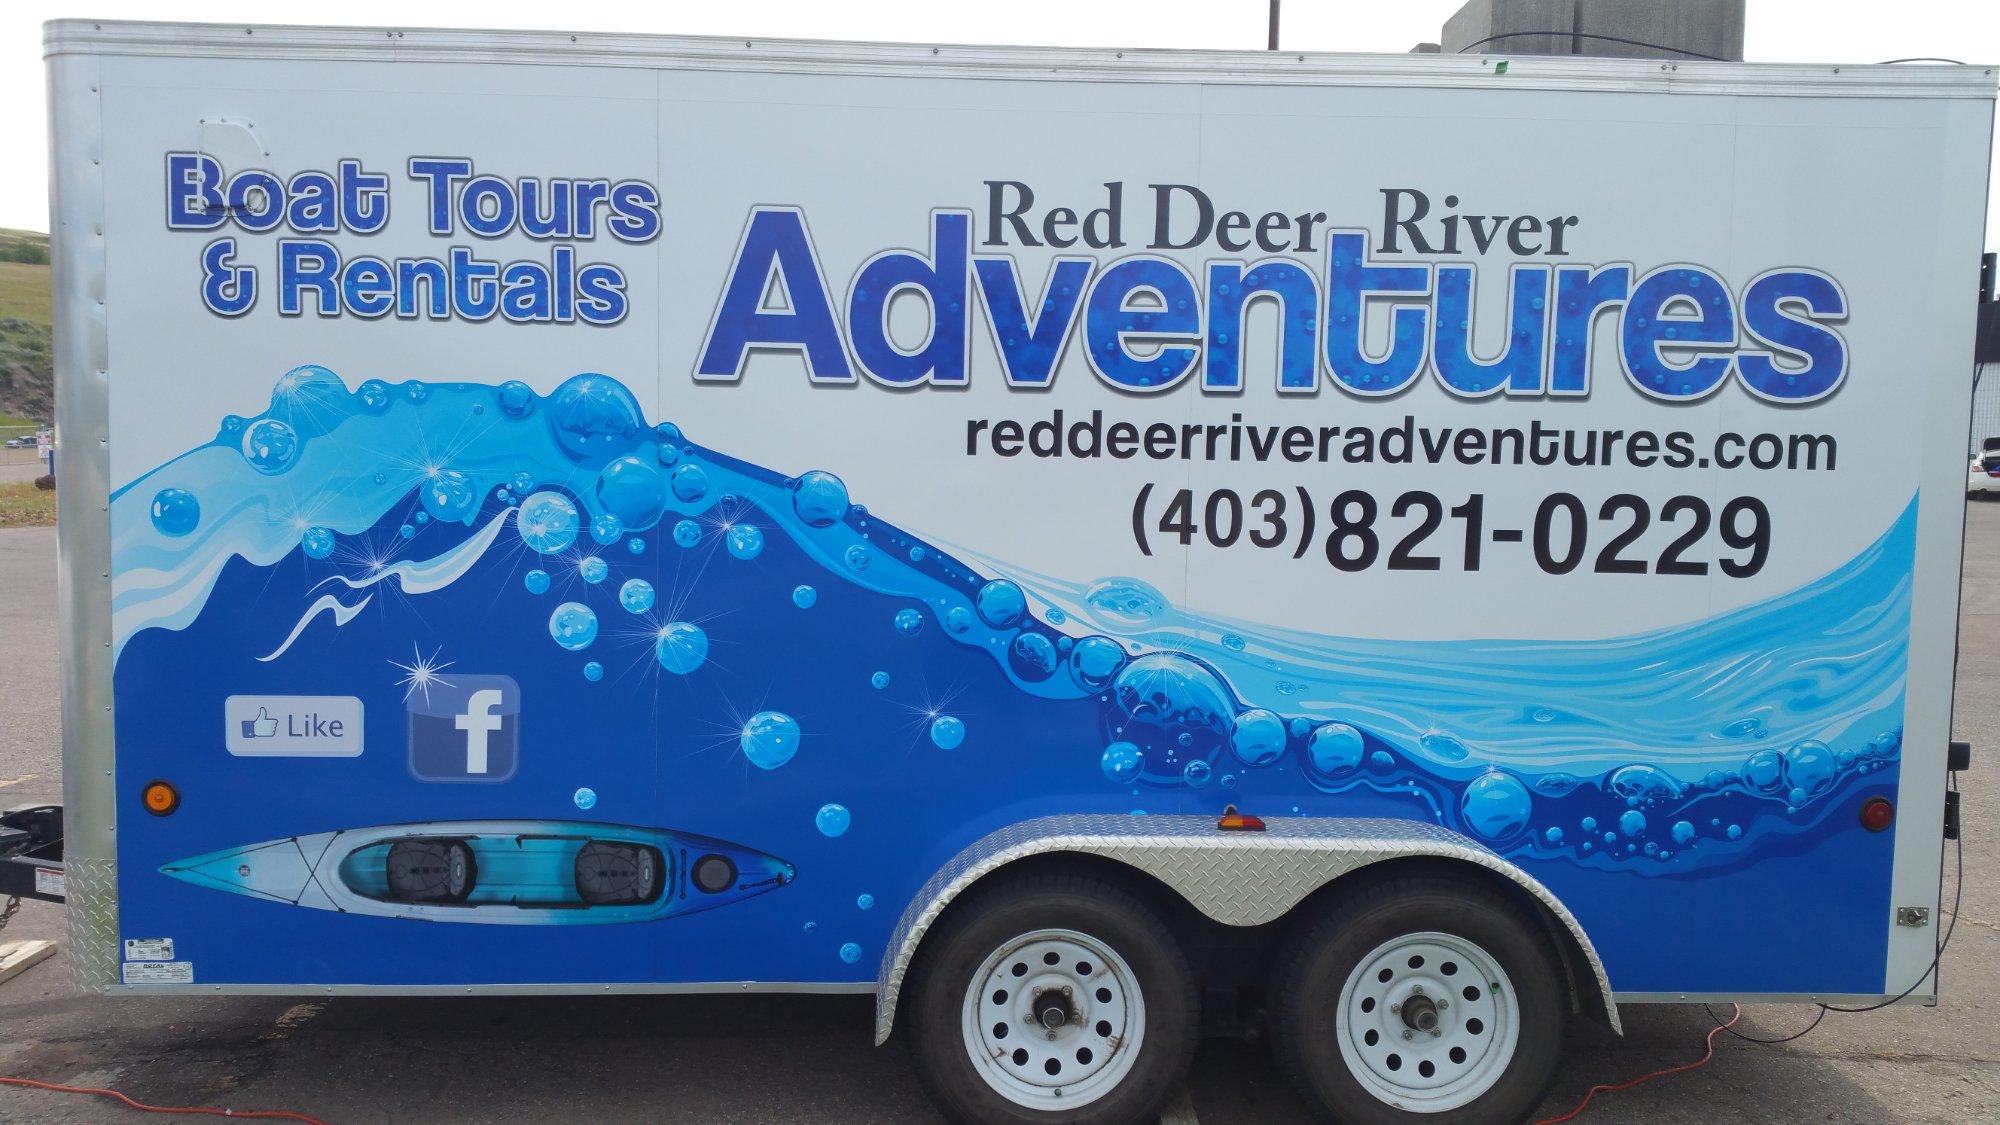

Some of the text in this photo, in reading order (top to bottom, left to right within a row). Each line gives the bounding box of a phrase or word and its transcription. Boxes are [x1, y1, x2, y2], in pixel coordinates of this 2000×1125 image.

[165, 152, 661, 241] Boat Tours
[982, 180, 1579, 255] Red Deer River
[201, 238, 628, 323] & Rentals
[693, 204, 1849, 408] Adventures
[966, 409, 1837, 470] reddeerriveradventures.com
[287, 714, 344, 738] Like
